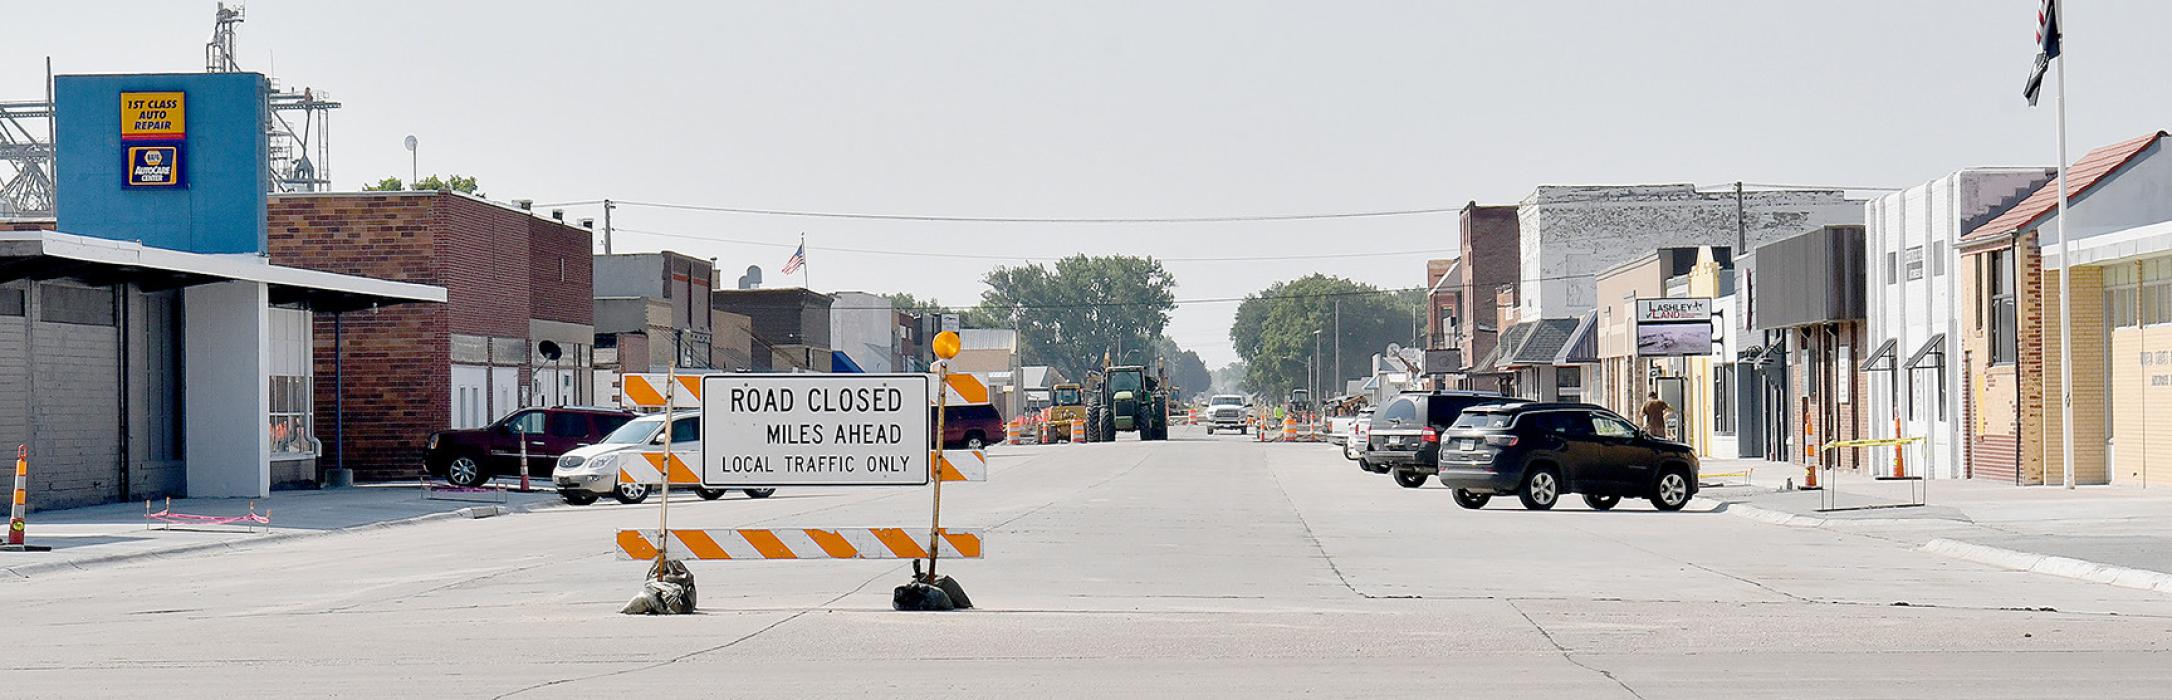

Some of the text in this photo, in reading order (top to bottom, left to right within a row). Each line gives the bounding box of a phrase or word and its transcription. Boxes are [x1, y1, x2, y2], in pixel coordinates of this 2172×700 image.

[128, 100, 177, 109] 1ST CLASS
[139, 110, 167, 119] AUTO
[134, 121, 172, 130] REPAIR
[1648, 301, 1693, 312] LASHLEY
[1651, 309, 1680, 319] LAND
[730, 387, 903, 413] ROAD CLOSED
[766, 423, 902, 445] MILES AHEAD
[721, 455, 911, 473] LOCAL TRAFFIC ONLY
